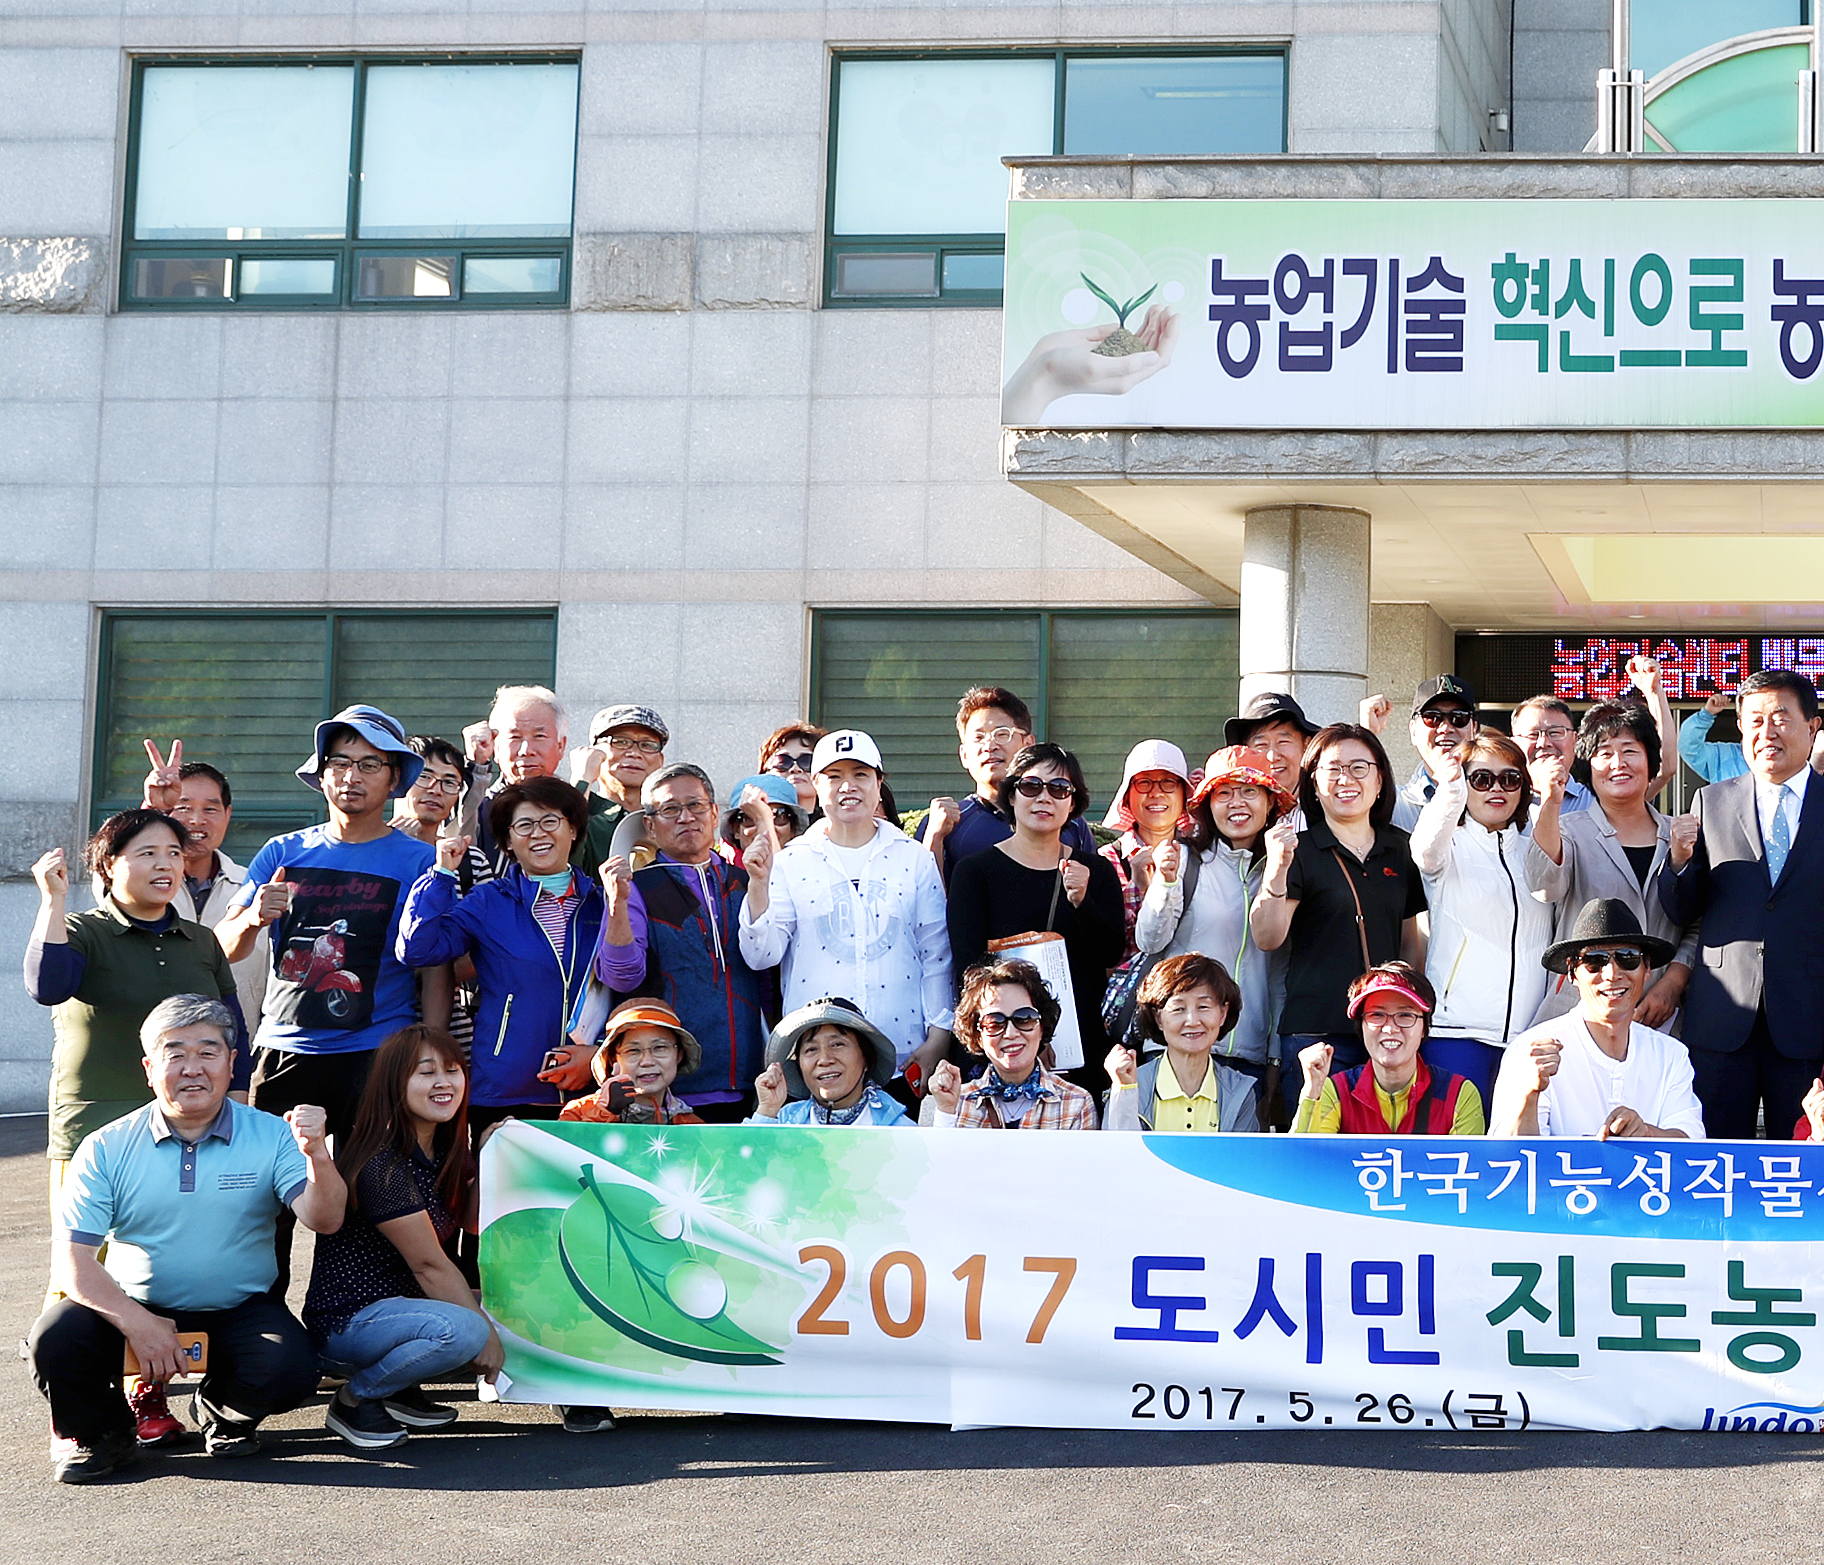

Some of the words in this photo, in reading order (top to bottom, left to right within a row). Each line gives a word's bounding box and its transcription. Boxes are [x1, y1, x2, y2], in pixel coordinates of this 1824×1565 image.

[1207, 253, 1466, 378] 농업기술
[1490, 252, 1748, 373] 혁신으로
[835, 736, 853, 753] FJ
[797, 1244, 1077, 1345] 2017
[1113, 1253, 1441, 1366] 도시민
[1131, 1383, 1265, 1424] 2017.
